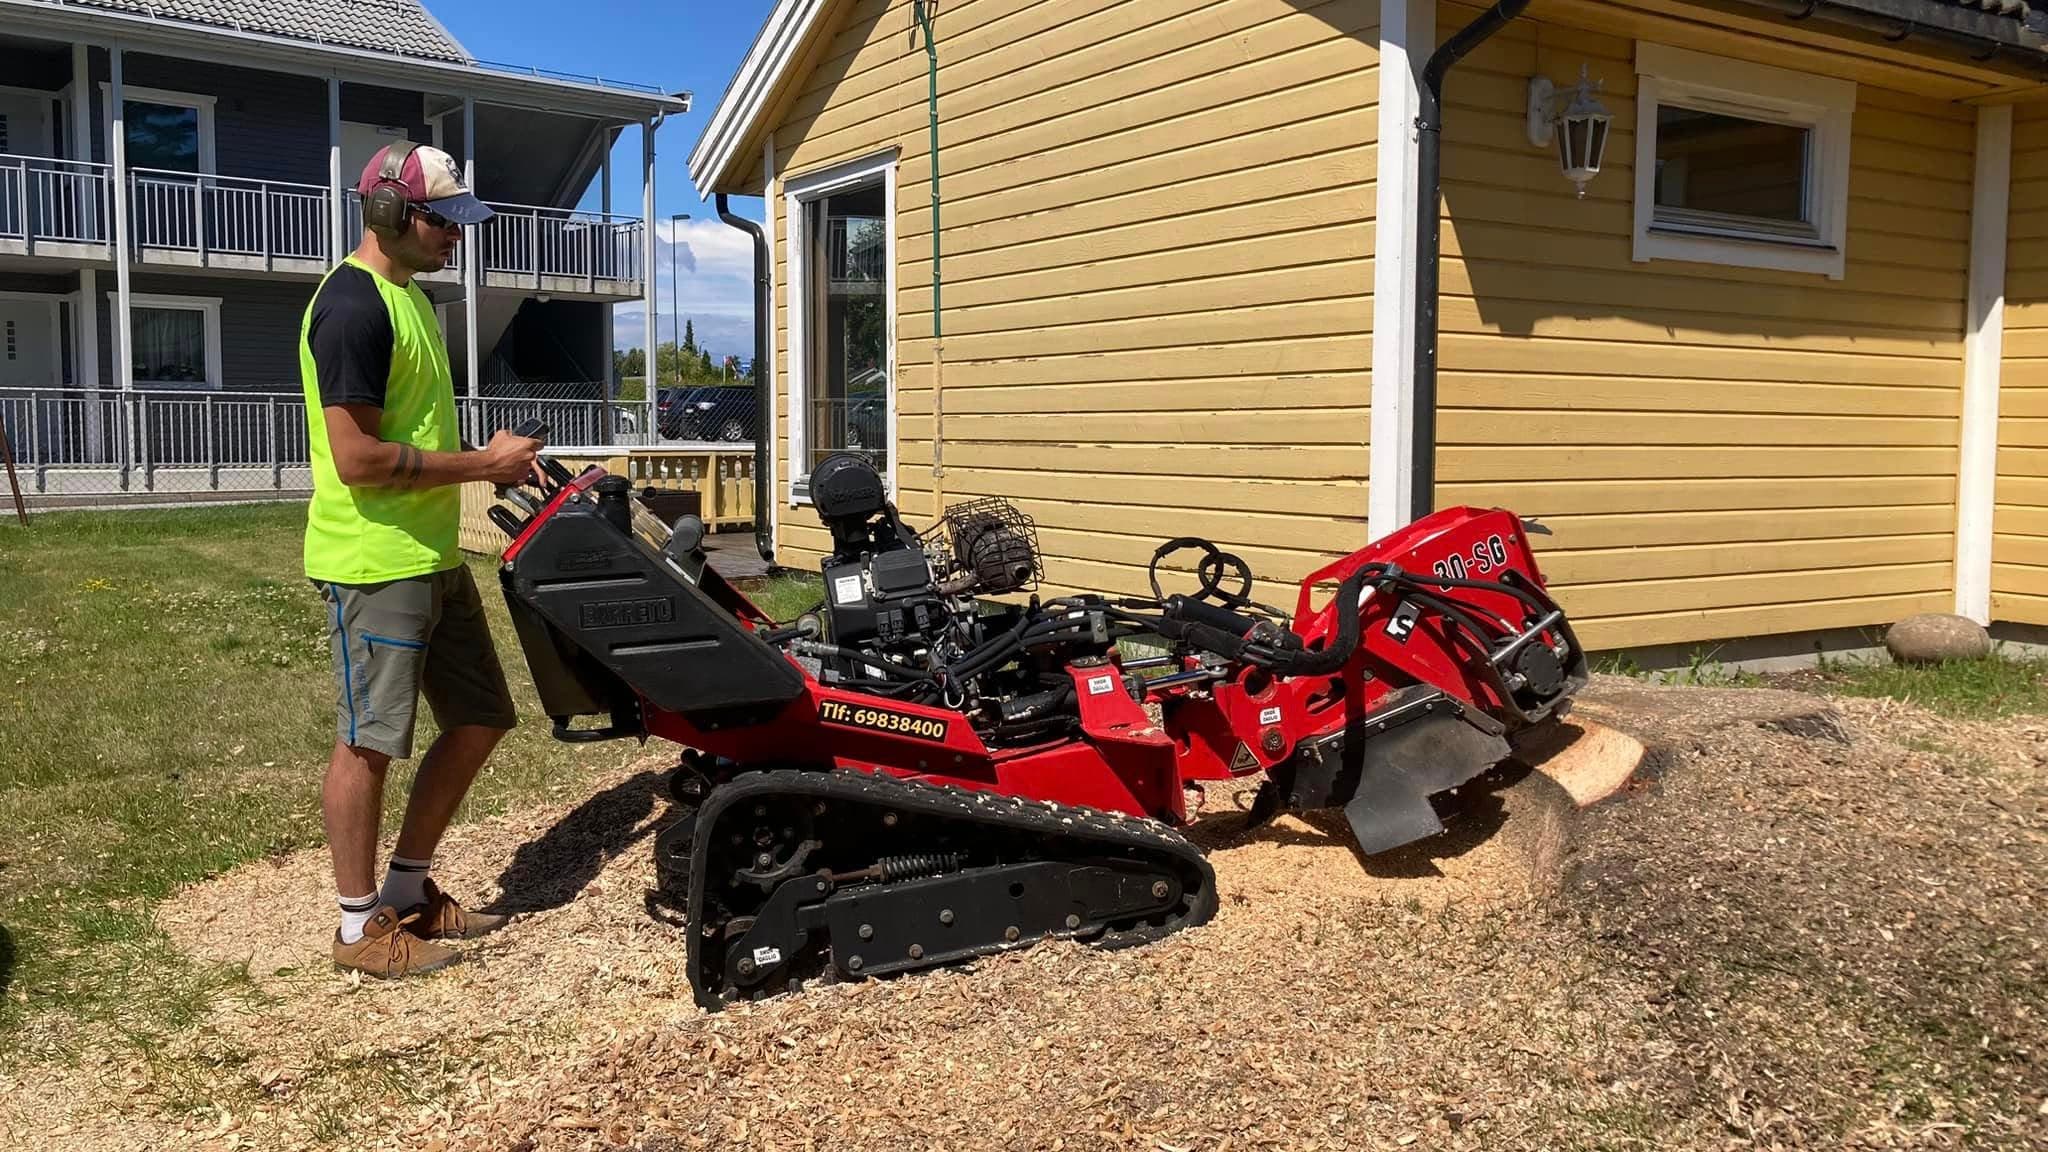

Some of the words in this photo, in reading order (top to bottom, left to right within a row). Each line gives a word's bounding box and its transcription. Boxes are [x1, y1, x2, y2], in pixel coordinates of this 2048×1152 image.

[1433, 534, 1507, 592] 30-SG
[582, 599, 673, 627] BARRETO
[822, 702, 851, 722] Tlf:
[854, 709, 944, 738] 69838400
